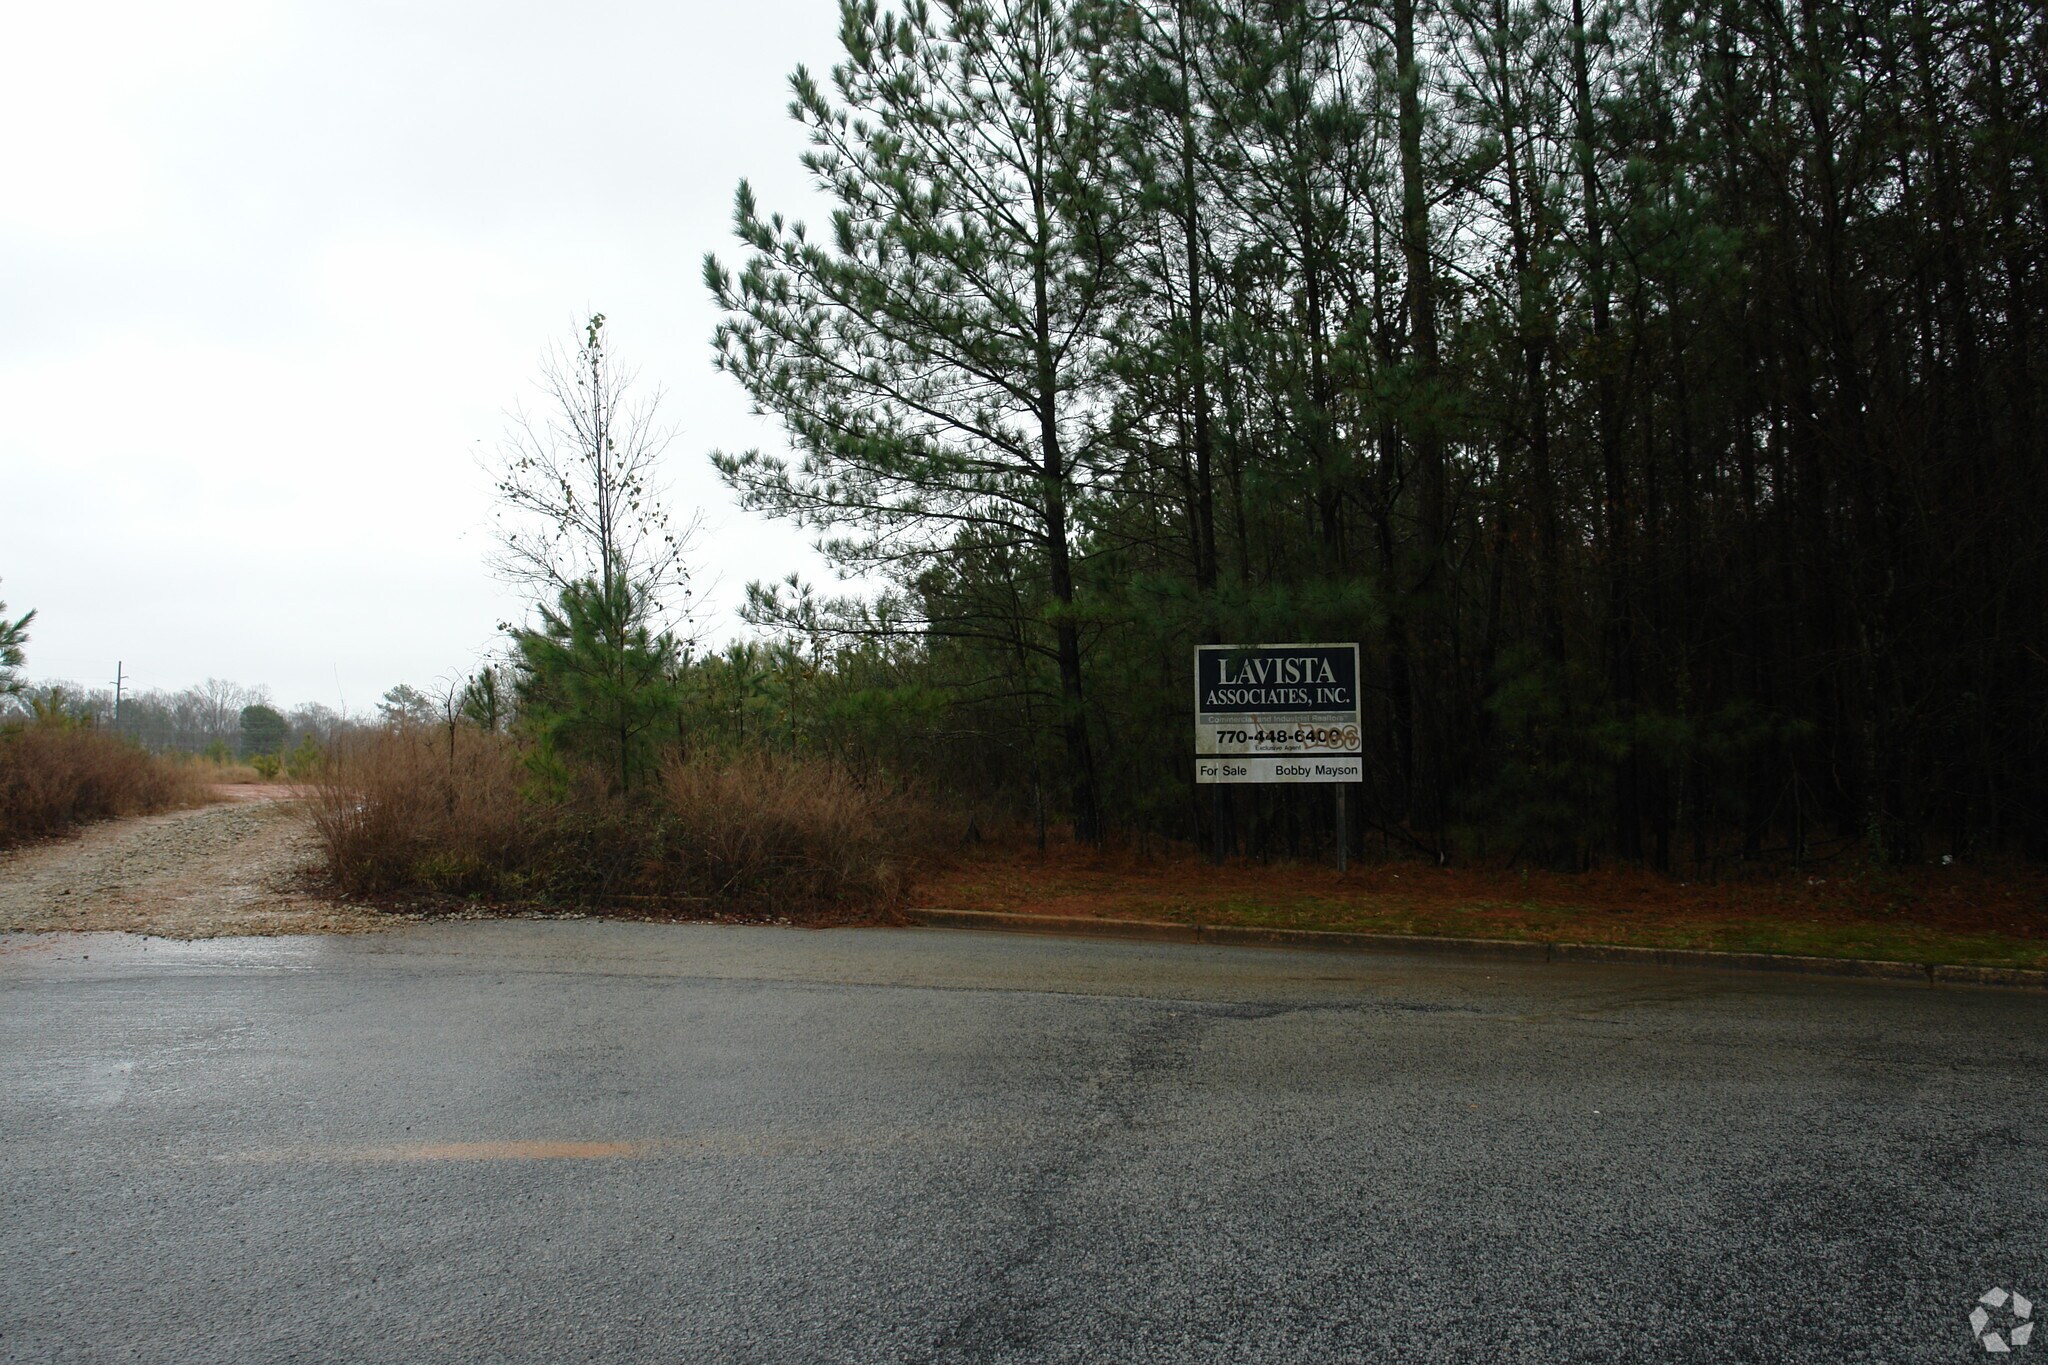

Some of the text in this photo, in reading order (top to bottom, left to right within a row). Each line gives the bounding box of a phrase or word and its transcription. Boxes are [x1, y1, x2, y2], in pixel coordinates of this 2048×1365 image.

[1218, 657, 1336, 685] LAVISTA
[1206, 687, 1350, 707] ASSOCIATES, INC.
[1273, 715, 1310, 723] Industrial
[1217, 729, 1340, 744] 770-448-6400
[1200, 764, 1358, 778] For Sale Bobby Mayson
